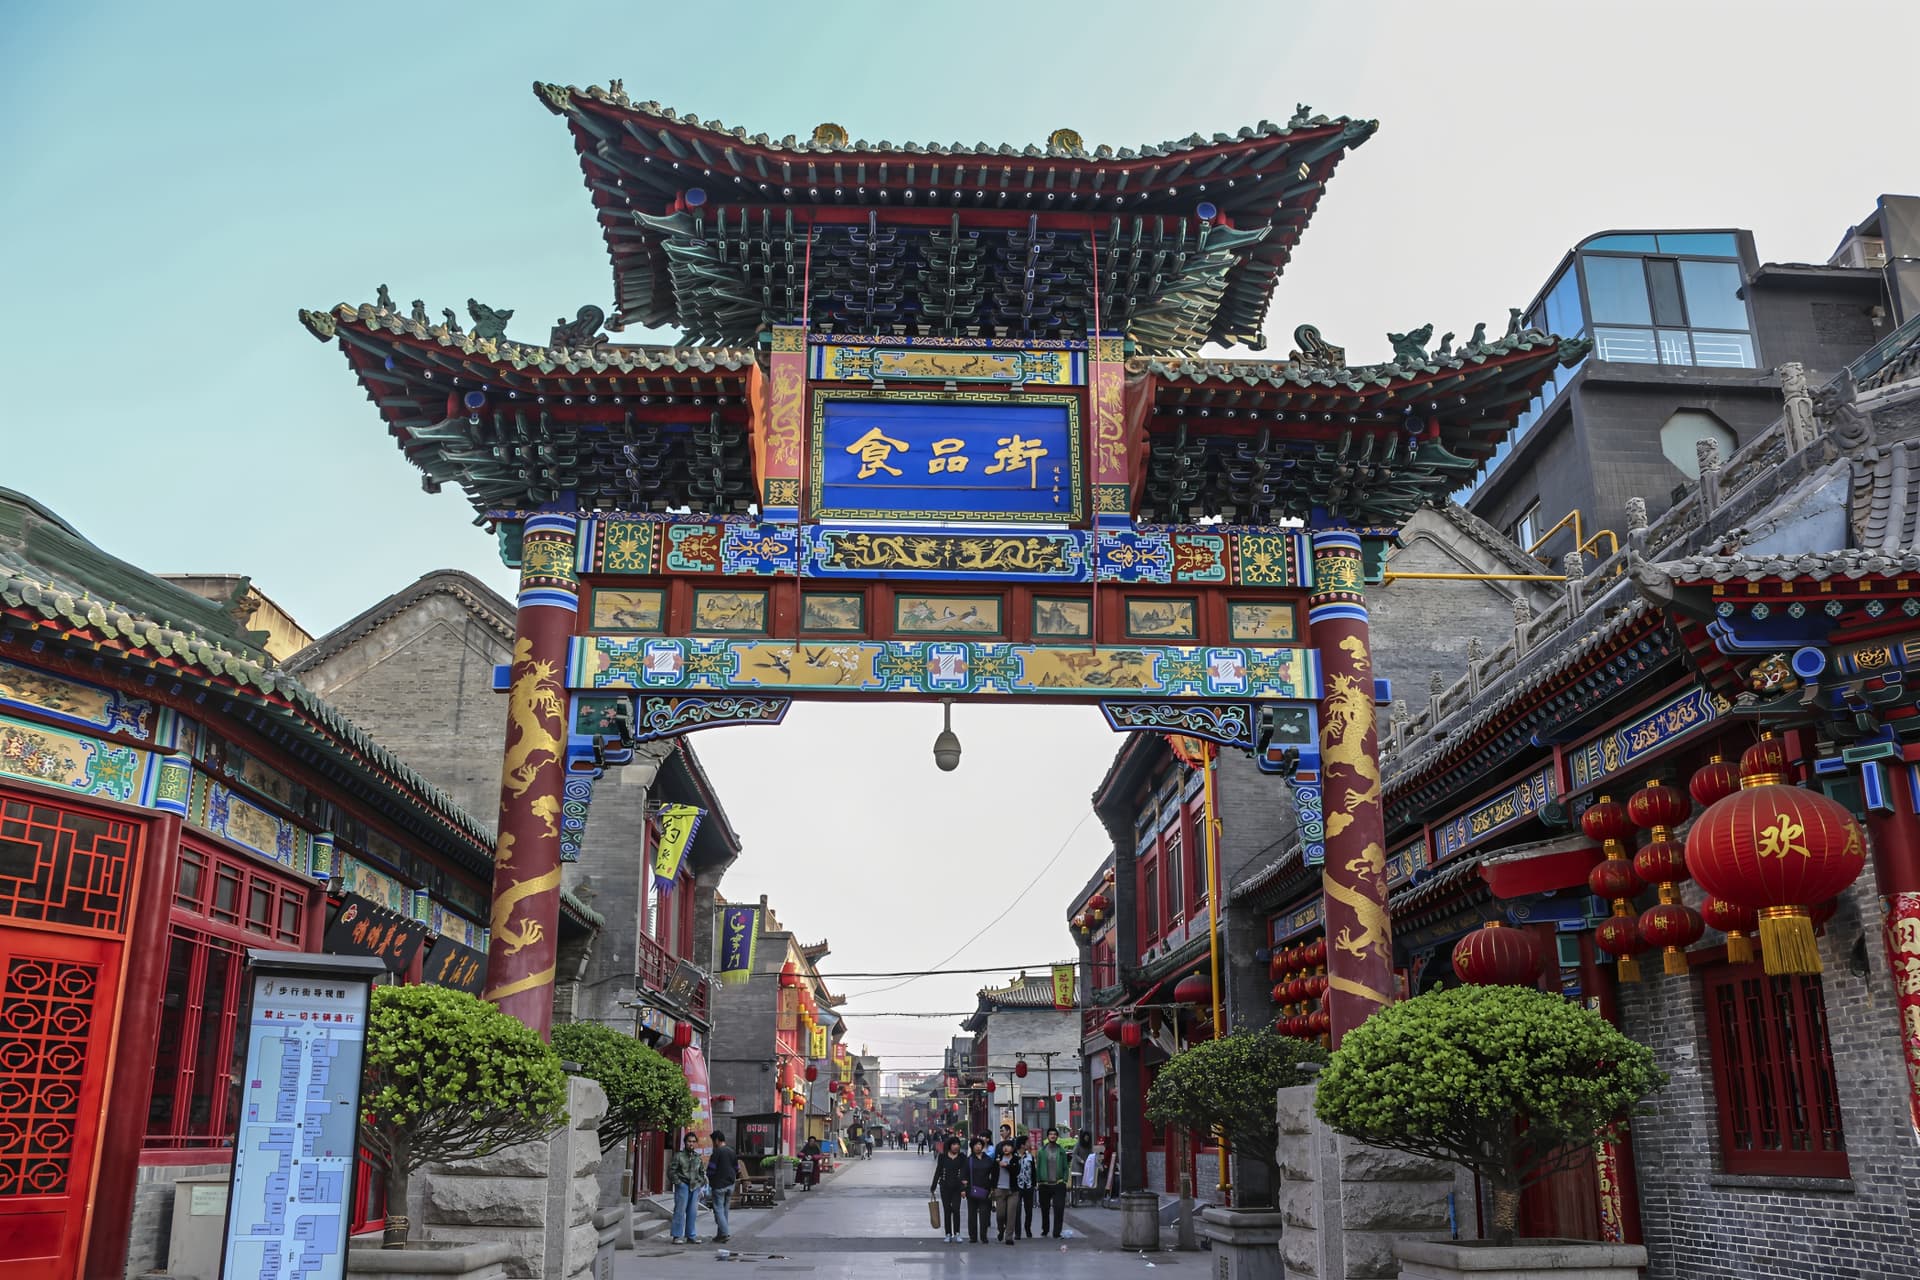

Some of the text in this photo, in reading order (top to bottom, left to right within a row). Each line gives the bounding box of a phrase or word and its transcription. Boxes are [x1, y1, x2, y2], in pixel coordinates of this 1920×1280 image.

[846, 427, 1048, 489] 食品街
[279, 986, 345, 999] 步行街导视图
[264, 1009, 354, 1023] 禁止一切车辆通行
